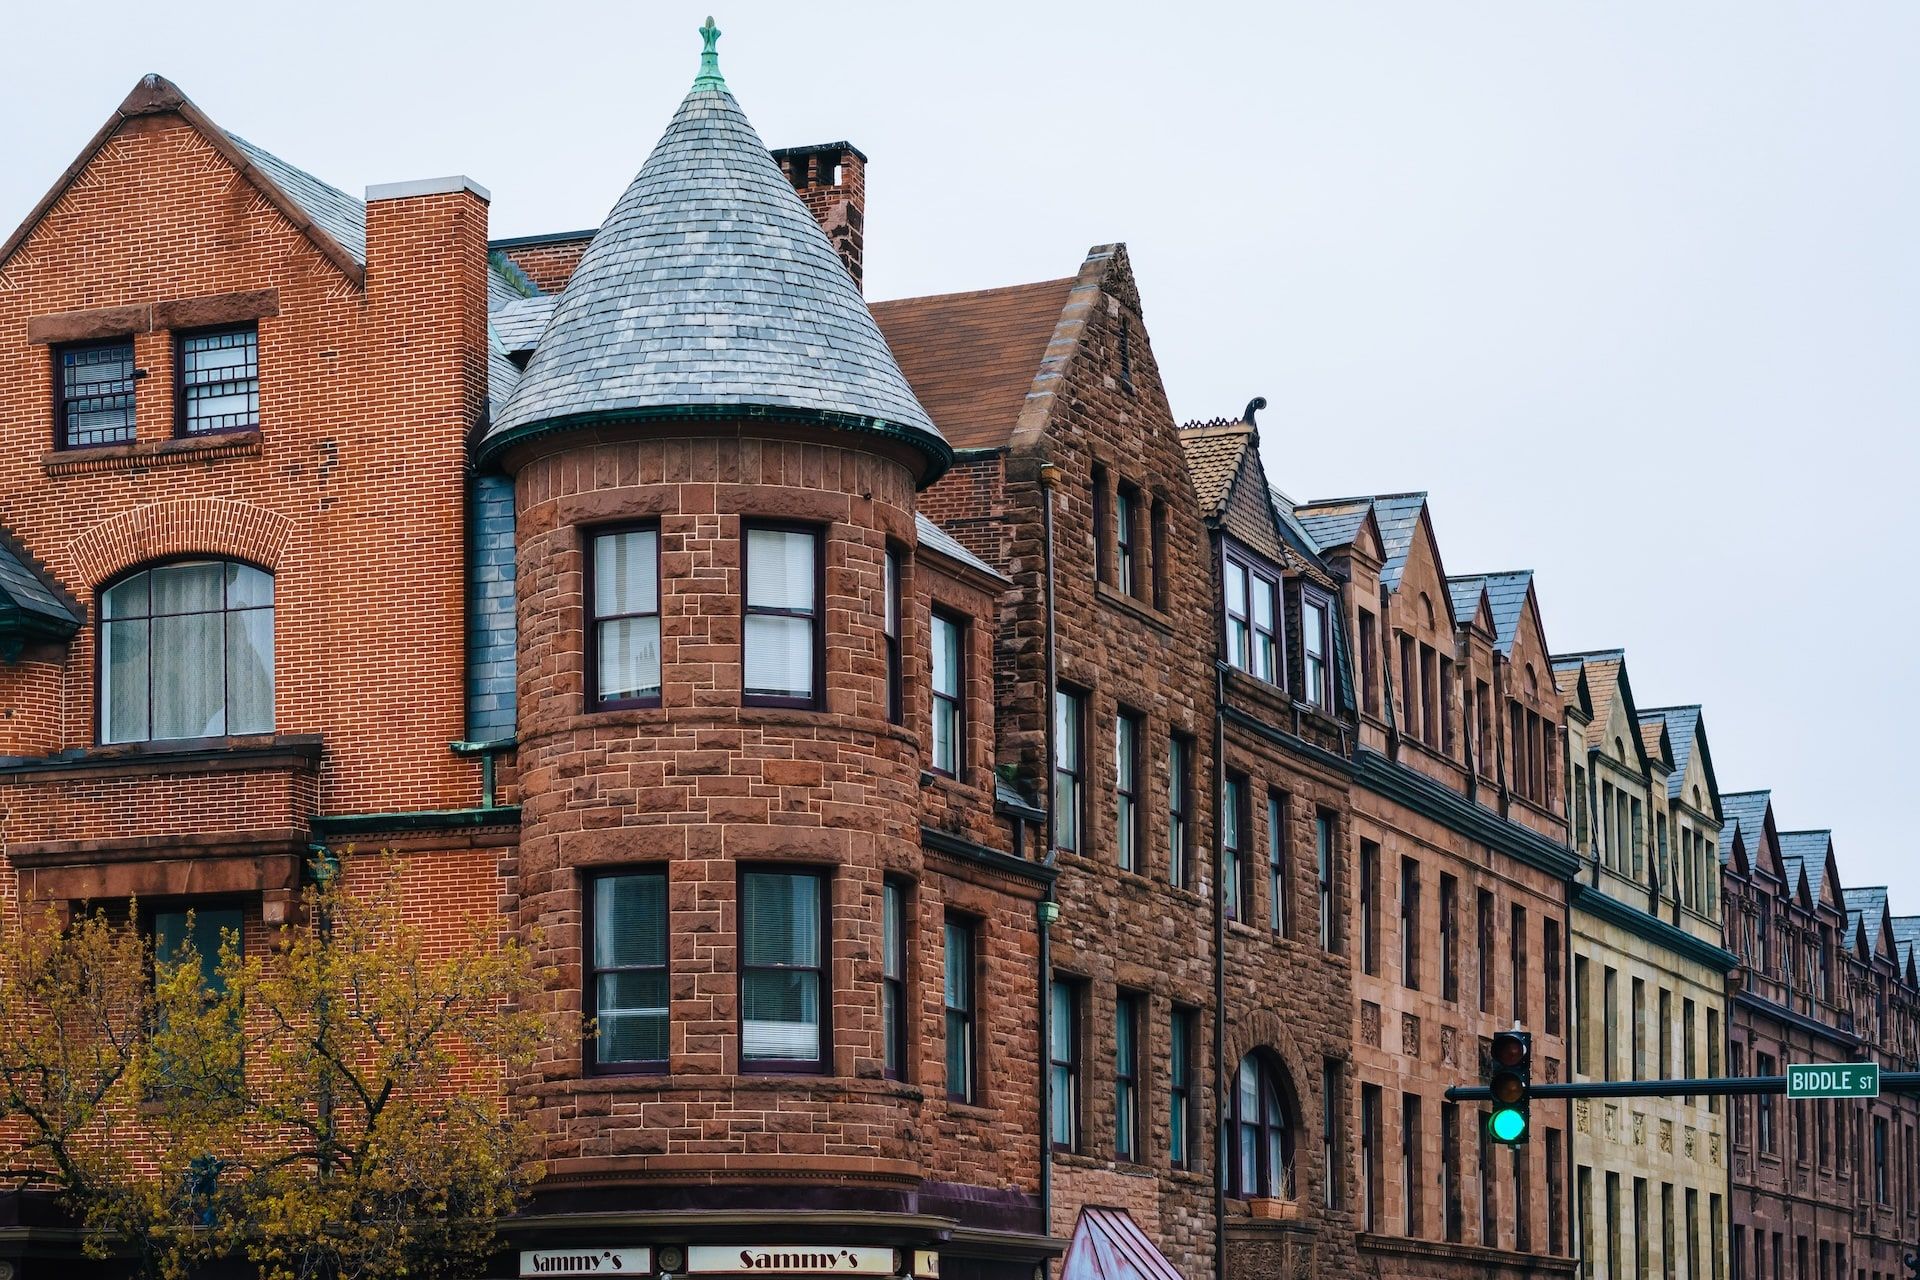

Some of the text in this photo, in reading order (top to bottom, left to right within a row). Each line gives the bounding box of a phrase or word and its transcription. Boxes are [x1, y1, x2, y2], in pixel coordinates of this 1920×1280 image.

[1792, 1071, 1873, 1091] BIDDLE ST
[533, 1252, 622, 1272] Sammy's
[740, 1250, 858, 1269] Sammy's
